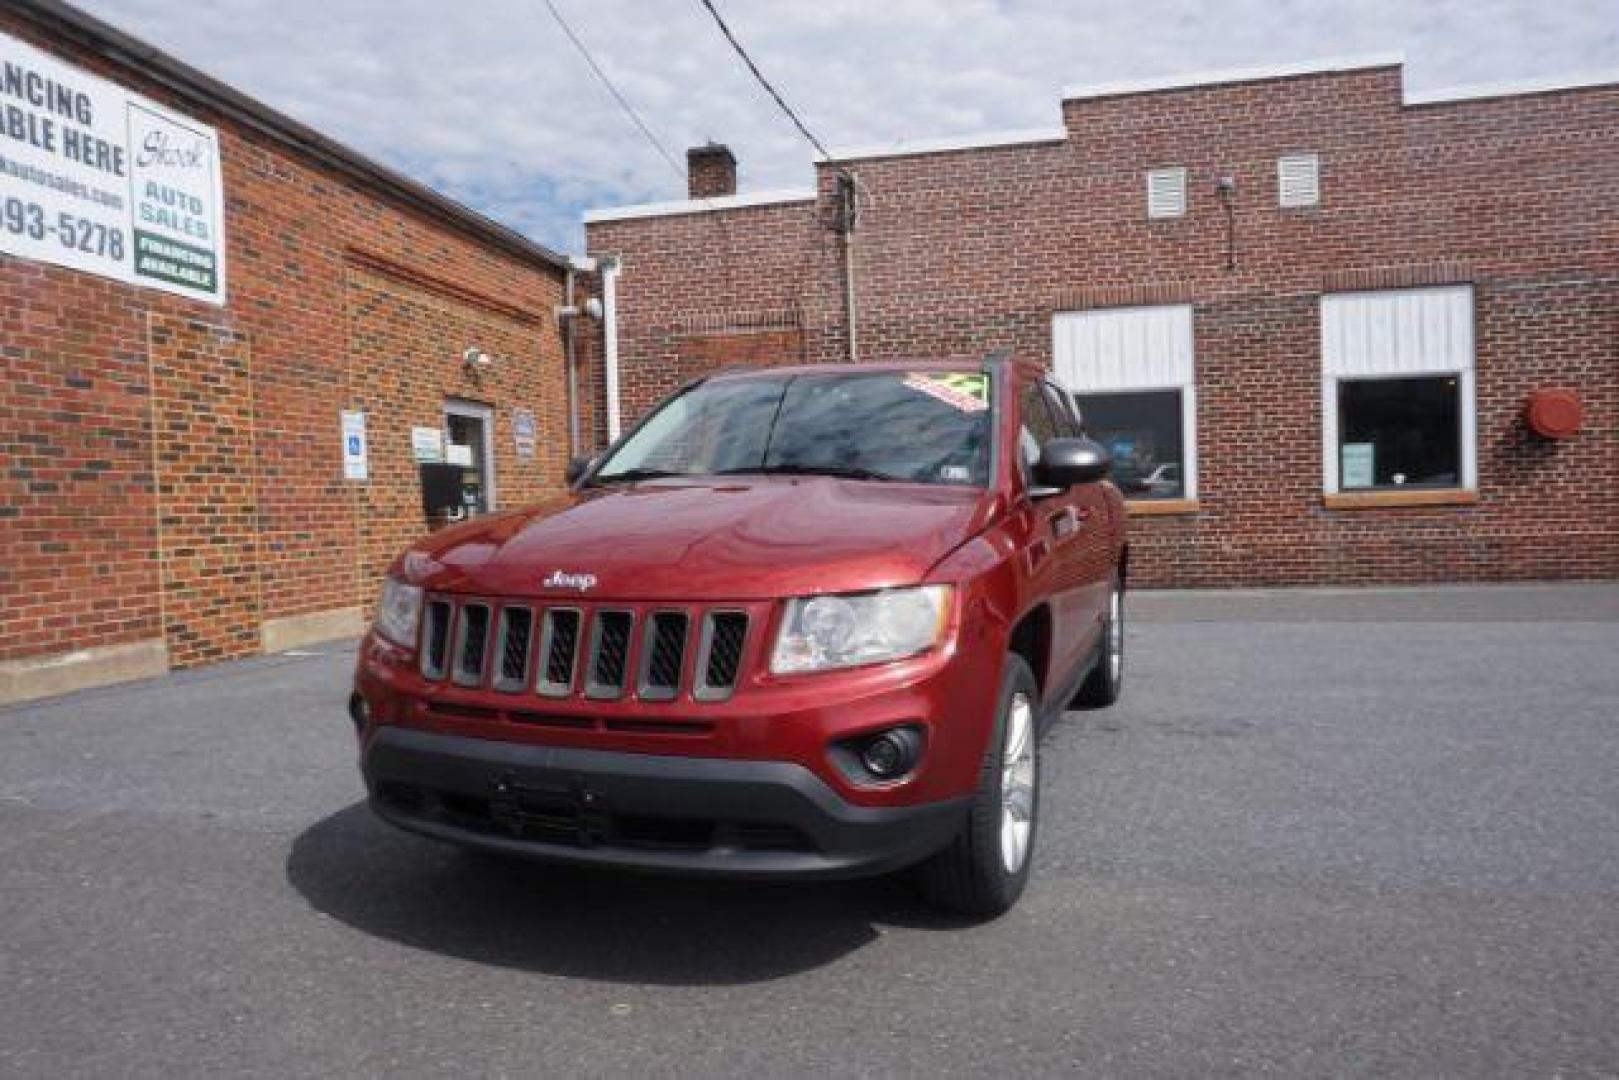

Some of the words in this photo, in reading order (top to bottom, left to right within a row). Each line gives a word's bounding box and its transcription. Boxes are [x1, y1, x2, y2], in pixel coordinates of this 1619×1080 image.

[0, 61, 92, 126] NCING
[63, 128, 124, 177] HERE
[146, 181, 202, 215] AUTO
[0, 196, 124, 261] 93-5278
[139, 202, 207, 238] SALES
[543, 569, 598, 592] Jeep
